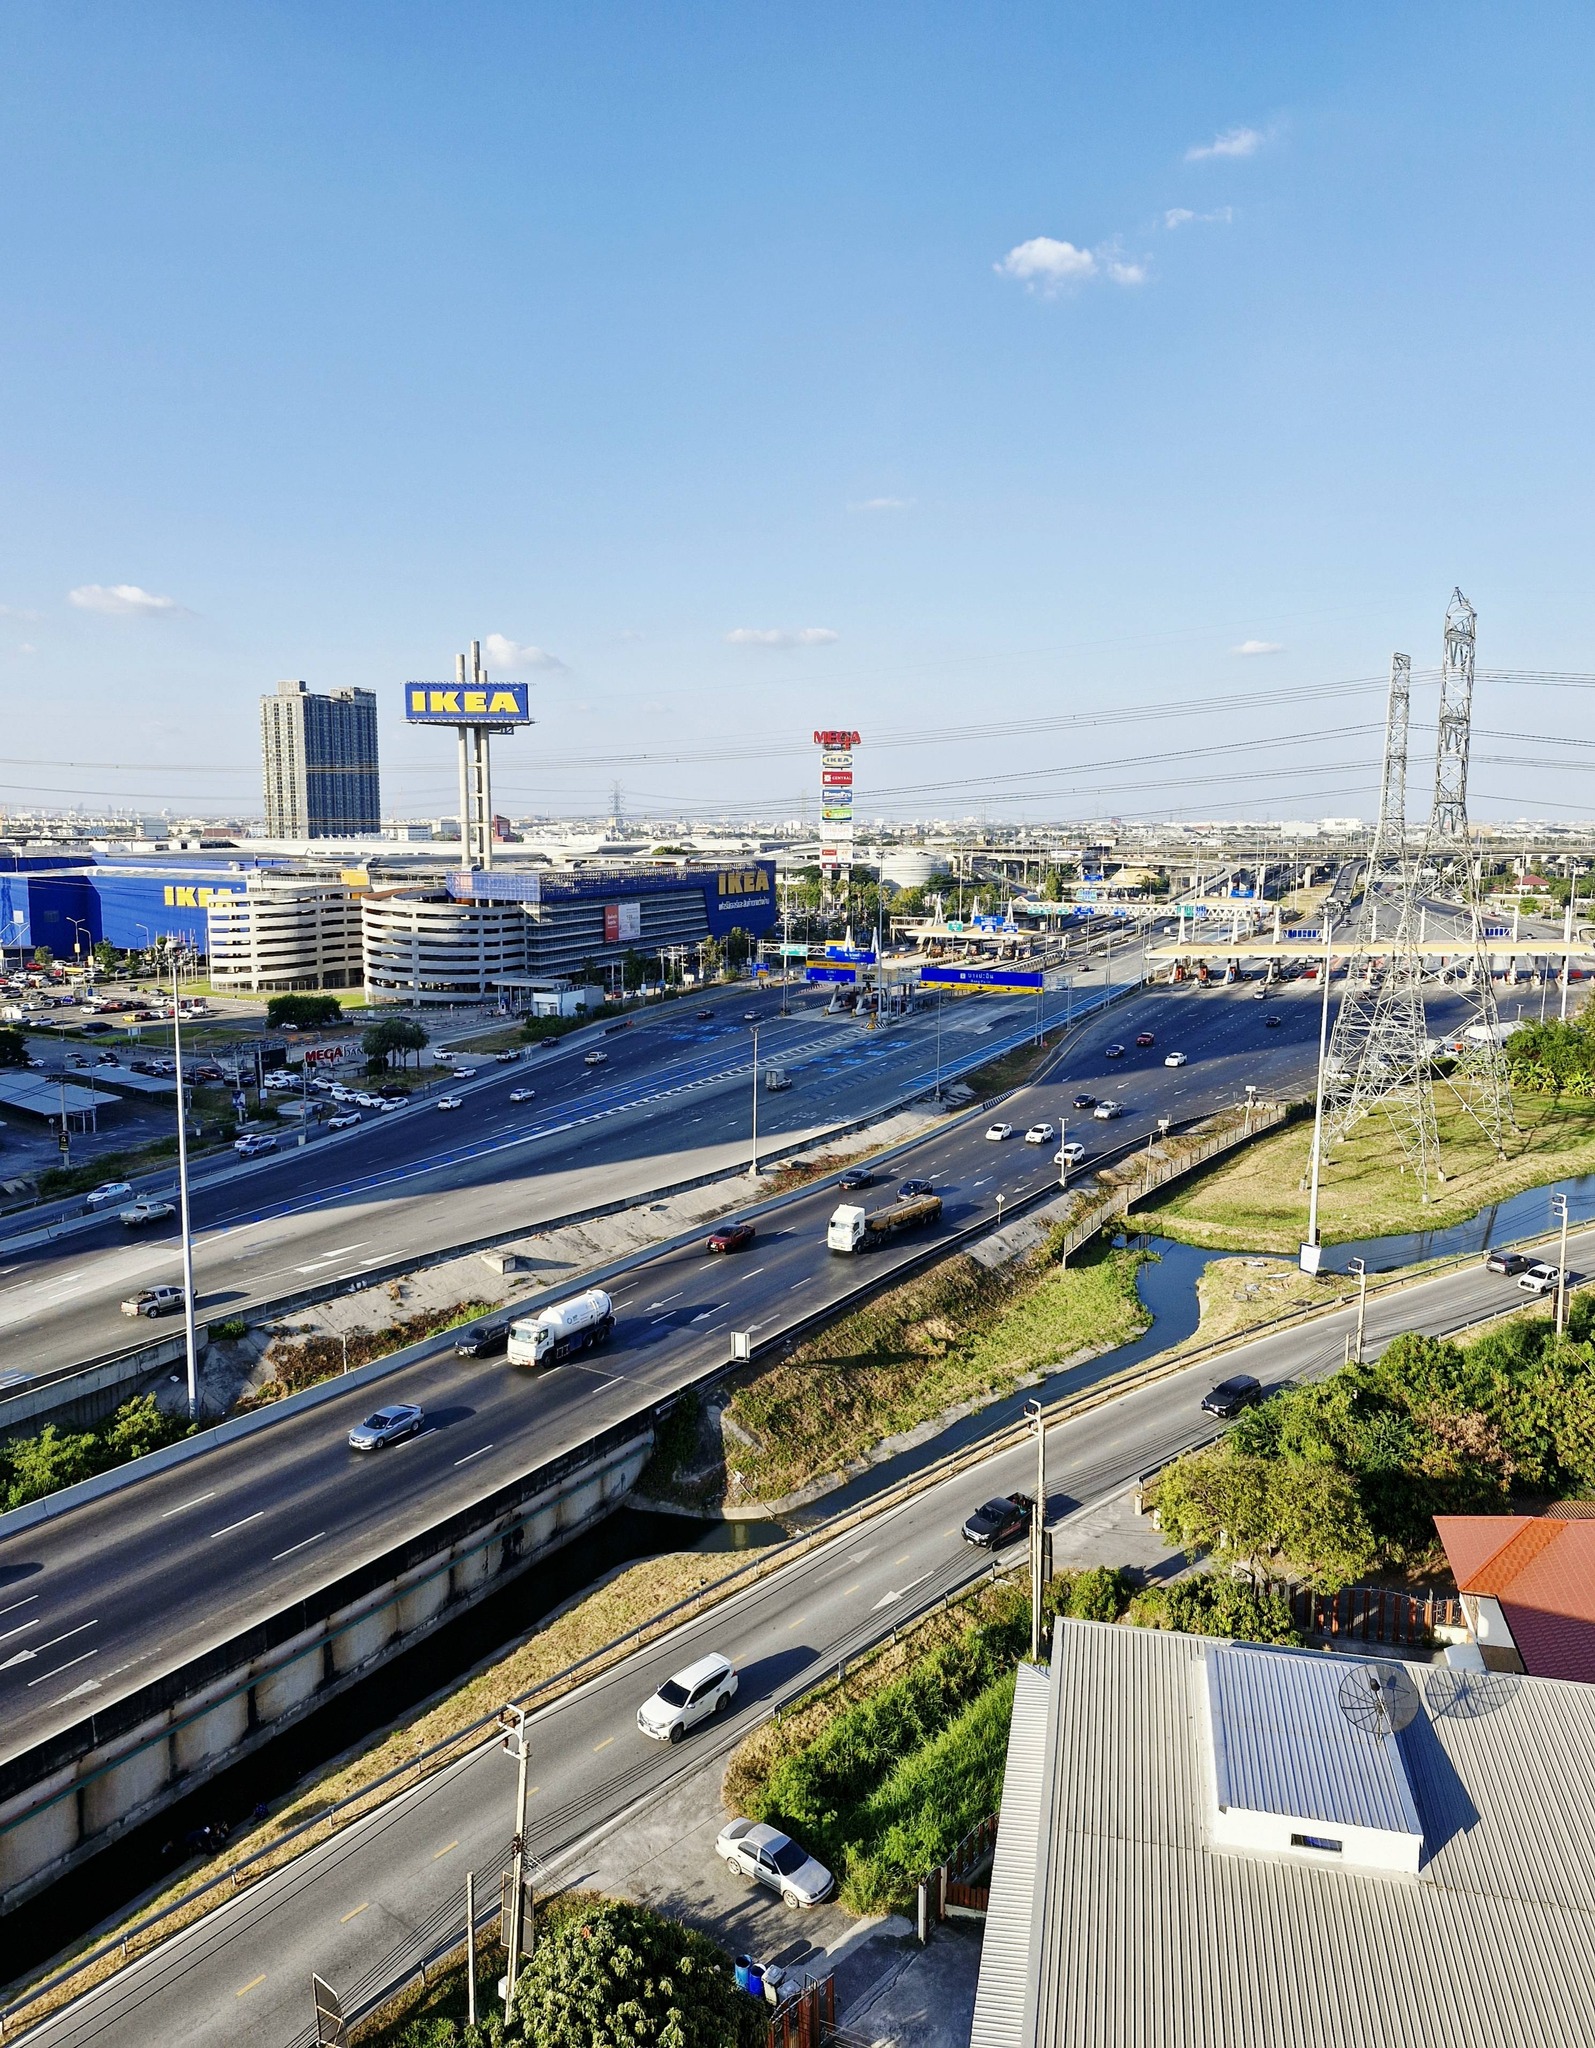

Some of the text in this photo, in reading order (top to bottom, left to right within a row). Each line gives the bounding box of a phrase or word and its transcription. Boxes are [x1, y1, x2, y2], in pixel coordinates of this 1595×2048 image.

[411, 691, 520, 712] IKEA
[813, 730, 861, 751] MEGA
[719, 870, 769, 895] IKEA
[304, 1047, 343, 1063] MEGA
